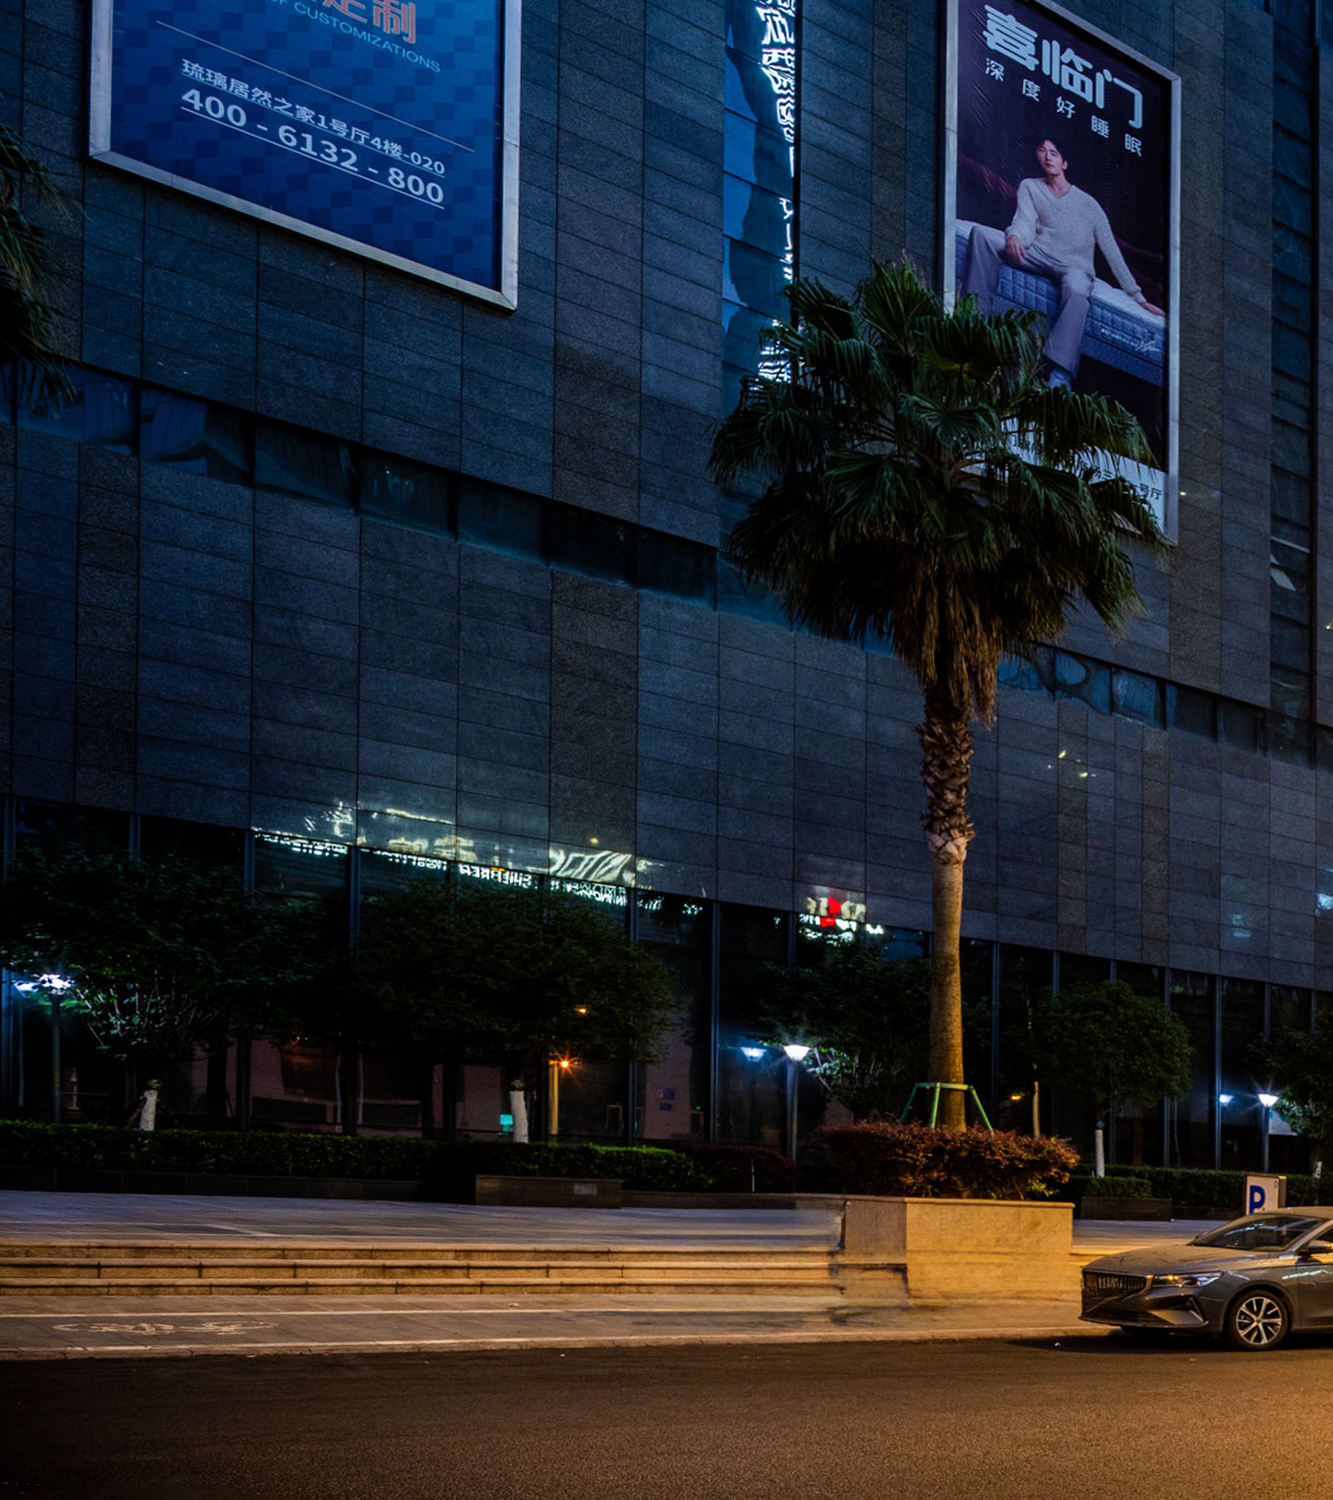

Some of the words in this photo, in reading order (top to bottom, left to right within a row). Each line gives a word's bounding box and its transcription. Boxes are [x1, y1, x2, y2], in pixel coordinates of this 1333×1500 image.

[294, 1, 441, 73] CUSTOMIZATIONS
[982, 4, 1143, 129] 喜临门
[985, 57, 1143, 157] 深度好睡眠
[1249, 1185, 1265, 1214] P
